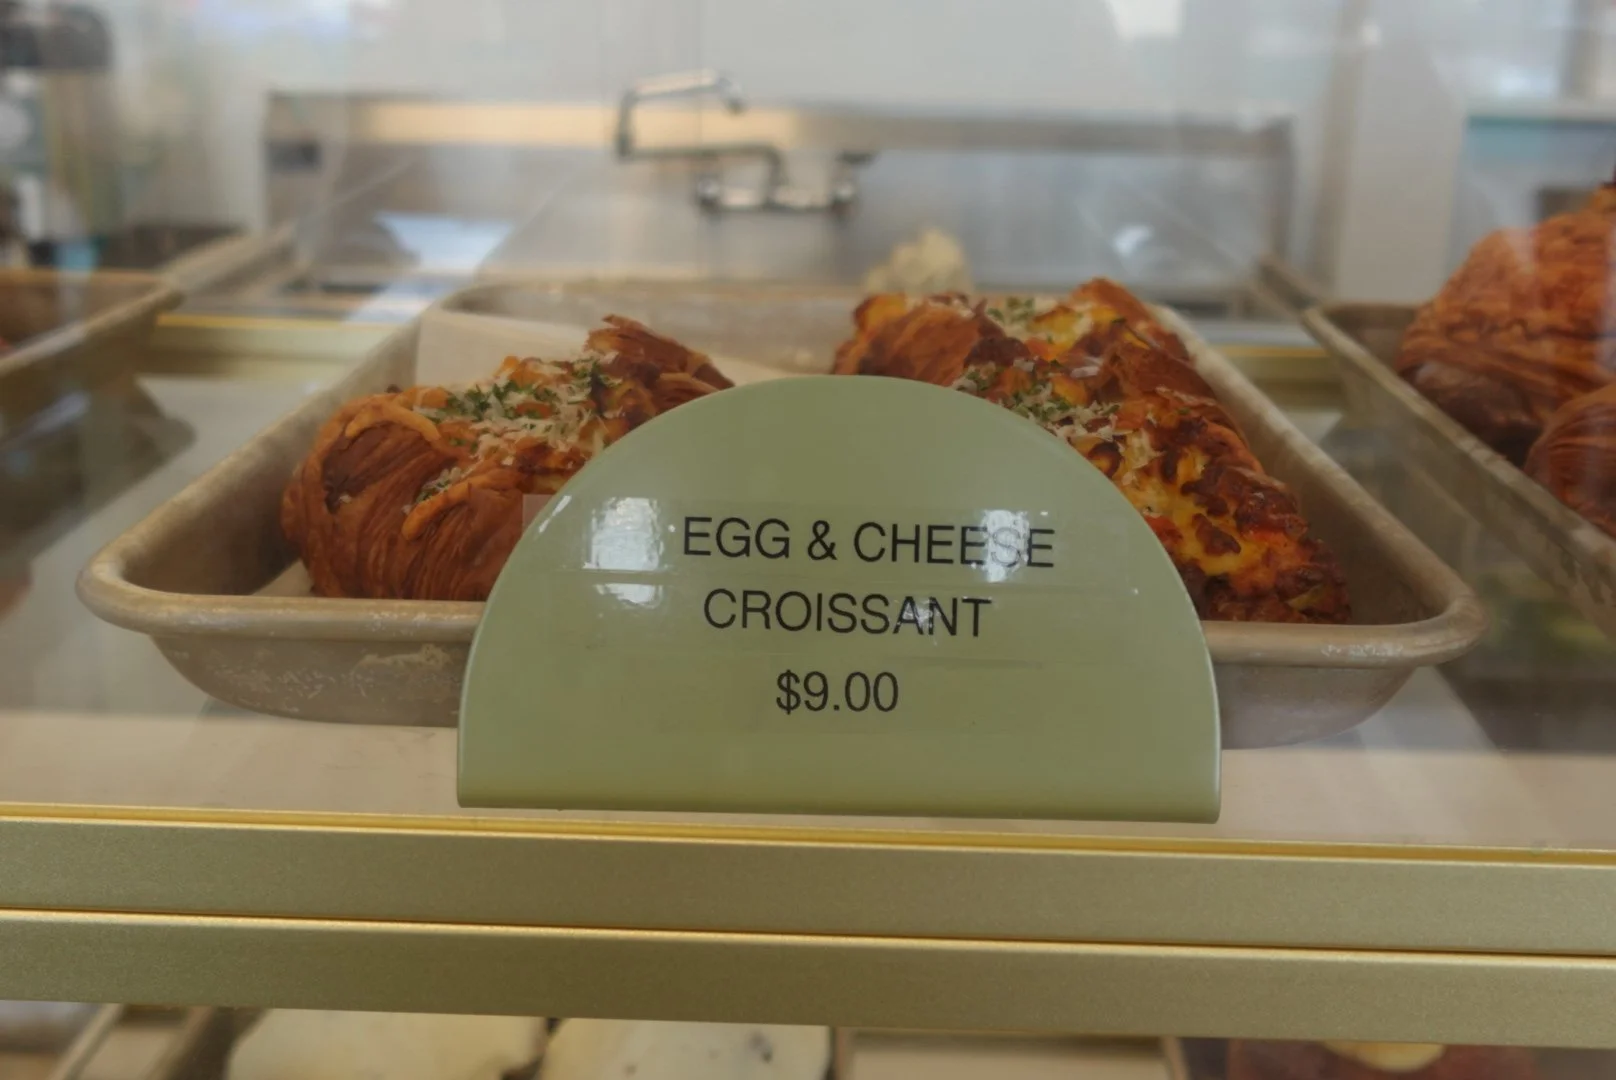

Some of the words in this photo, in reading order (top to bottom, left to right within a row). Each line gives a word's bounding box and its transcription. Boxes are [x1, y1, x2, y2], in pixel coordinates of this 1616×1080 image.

[683, 516, 791, 560] EGG
[807, 519, 838, 561] &
[853, 521, 1056, 568] CHEESE
[703, 588, 992, 638] CROISSANT
[775, 669, 899, 716] $9.00
